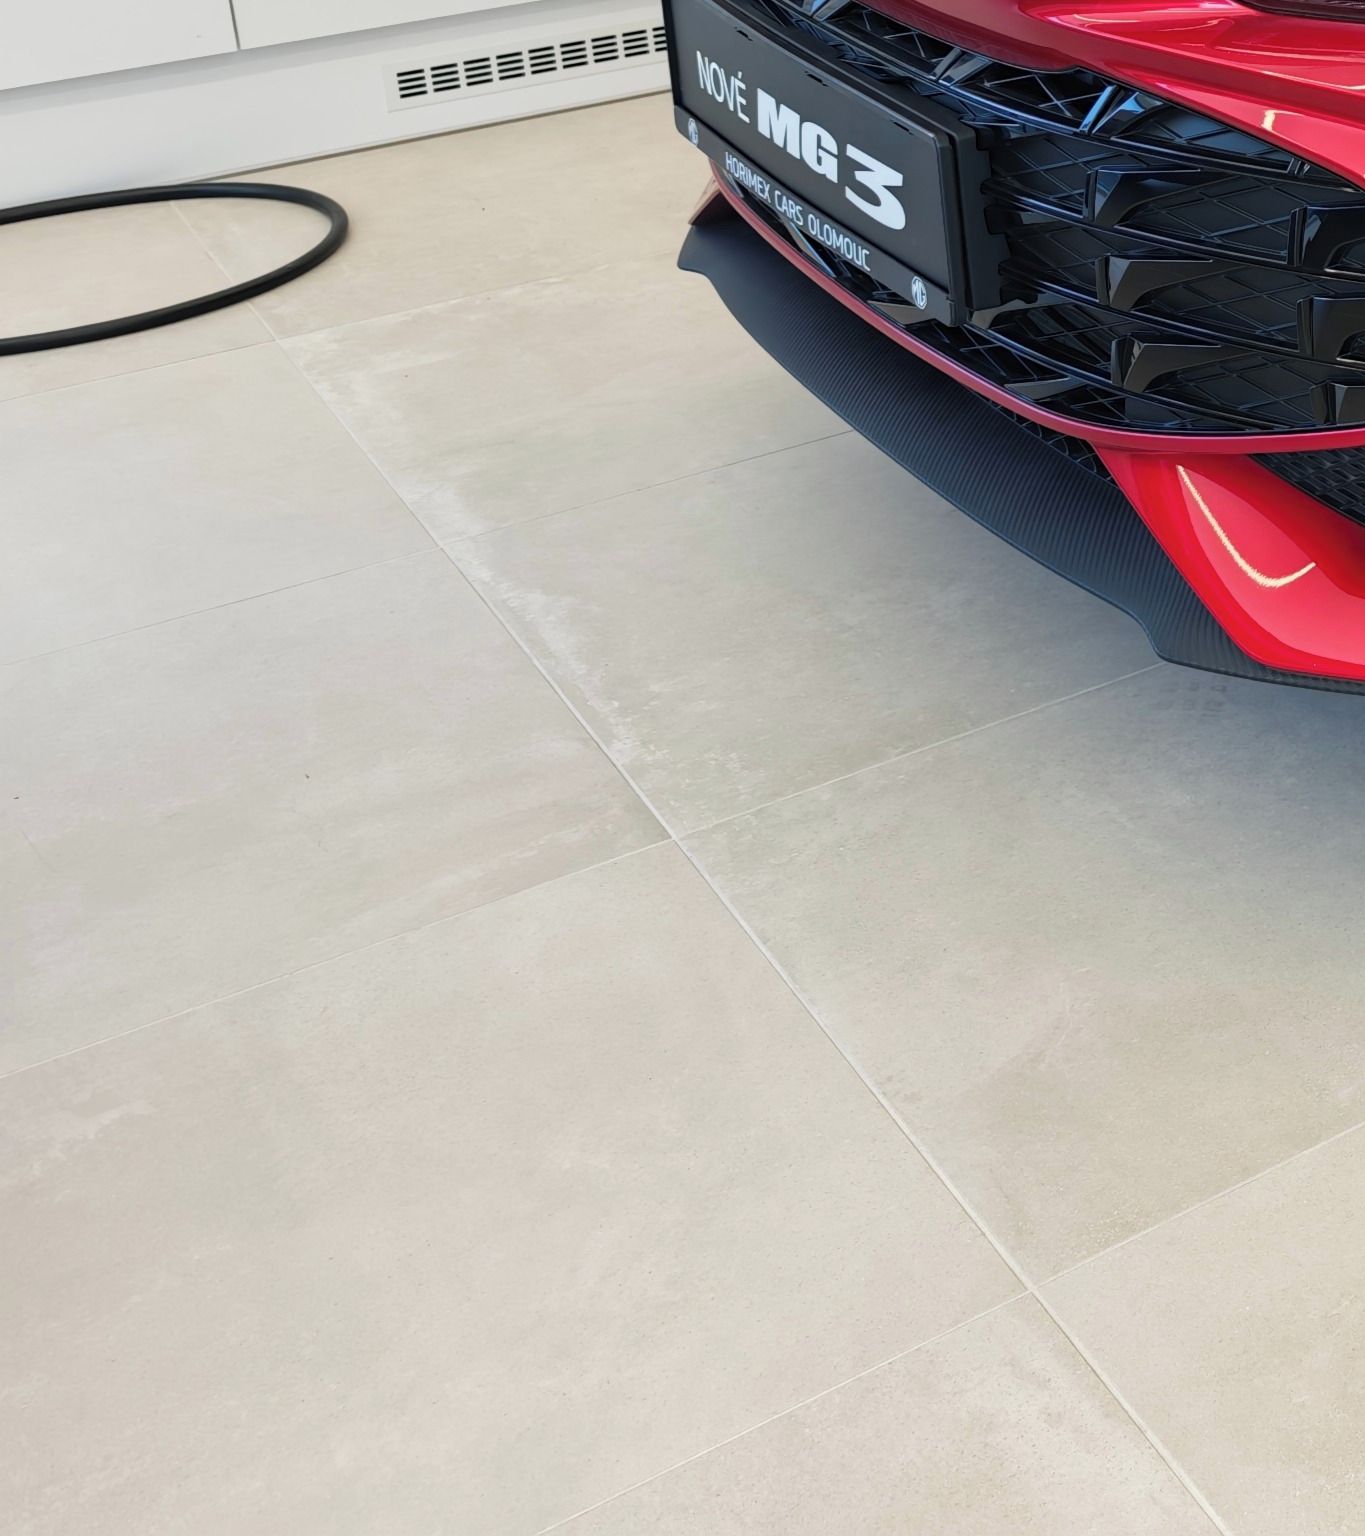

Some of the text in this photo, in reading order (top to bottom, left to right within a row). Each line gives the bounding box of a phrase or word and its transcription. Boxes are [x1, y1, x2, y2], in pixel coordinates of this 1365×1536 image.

[696, 50, 906, 230] NOVÉ MG 3
[724, 151, 871, 272] HORIMEX CARS OLOMOUC
[912, 277, 927, 309] MG
